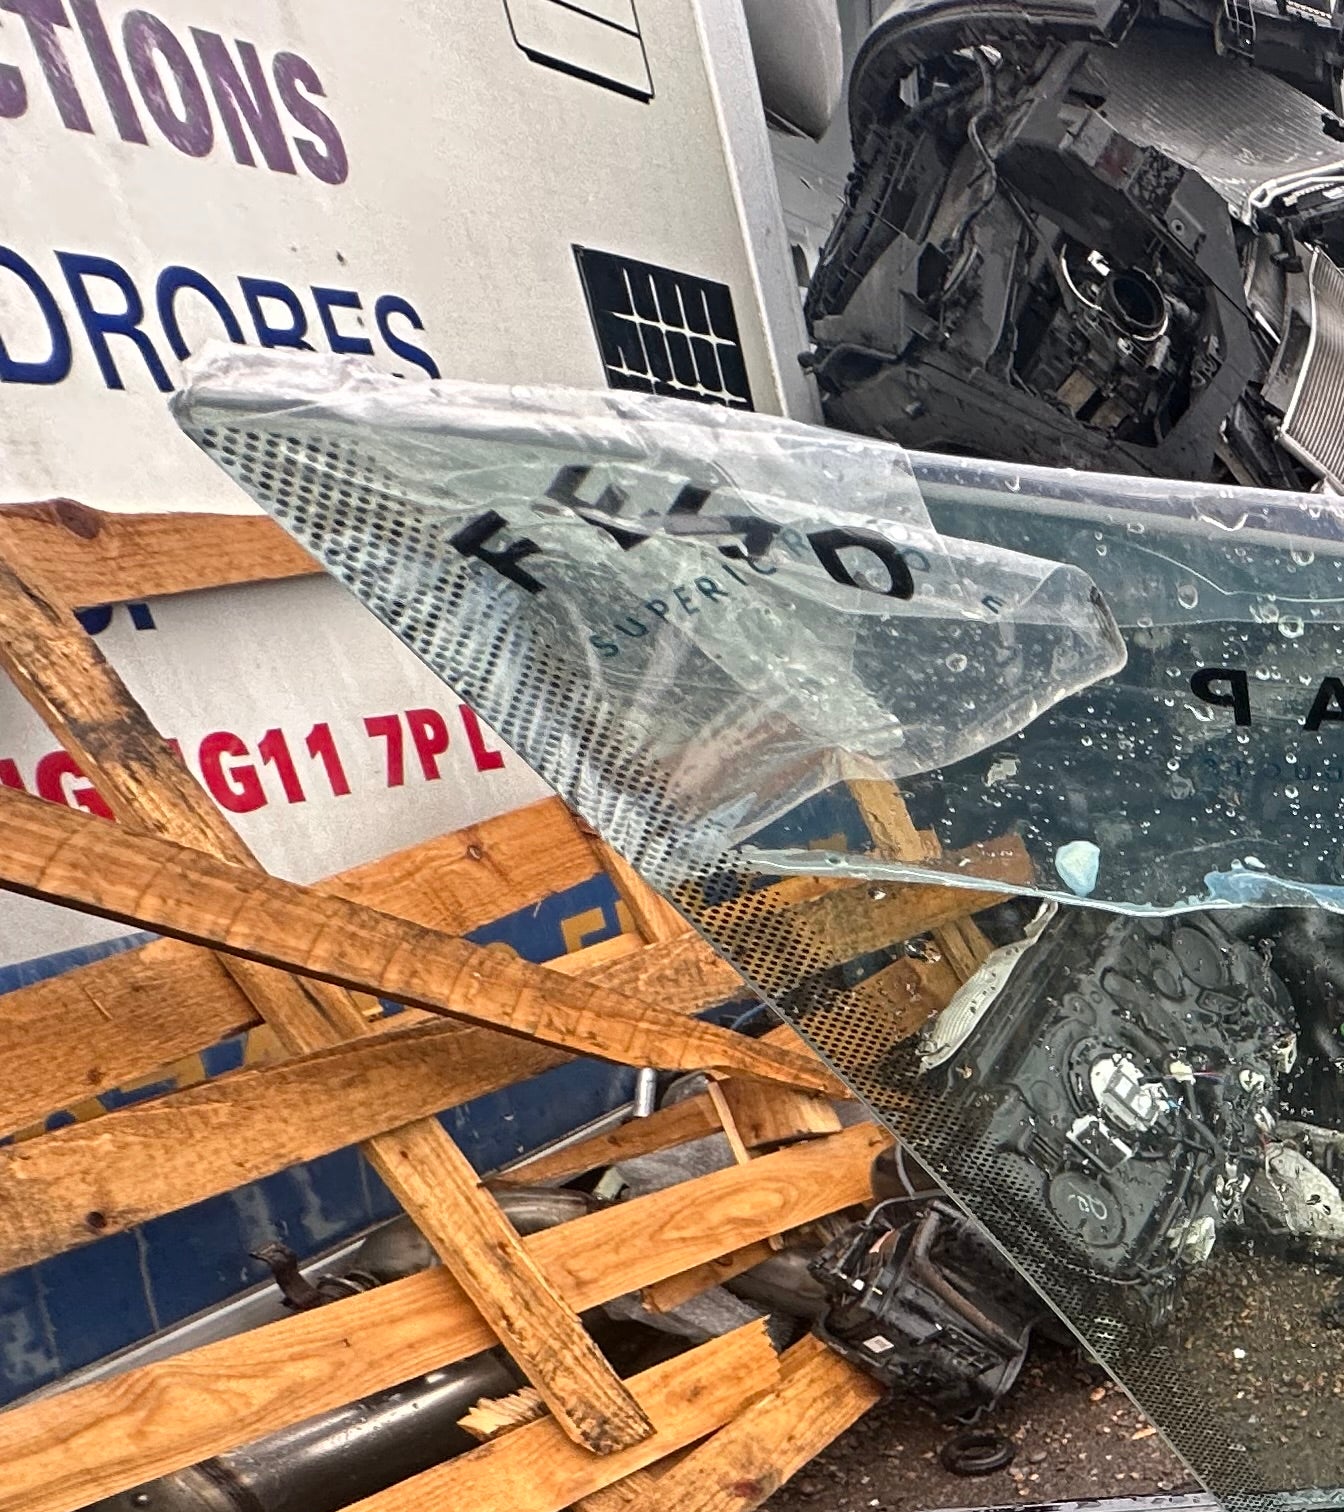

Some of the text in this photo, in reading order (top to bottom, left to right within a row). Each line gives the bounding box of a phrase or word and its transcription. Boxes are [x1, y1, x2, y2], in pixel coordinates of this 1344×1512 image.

[0, 0, 349, 186] TIONS
[165, 722, 352, 814] G11
[363, 703, 505, 788] 7PL
